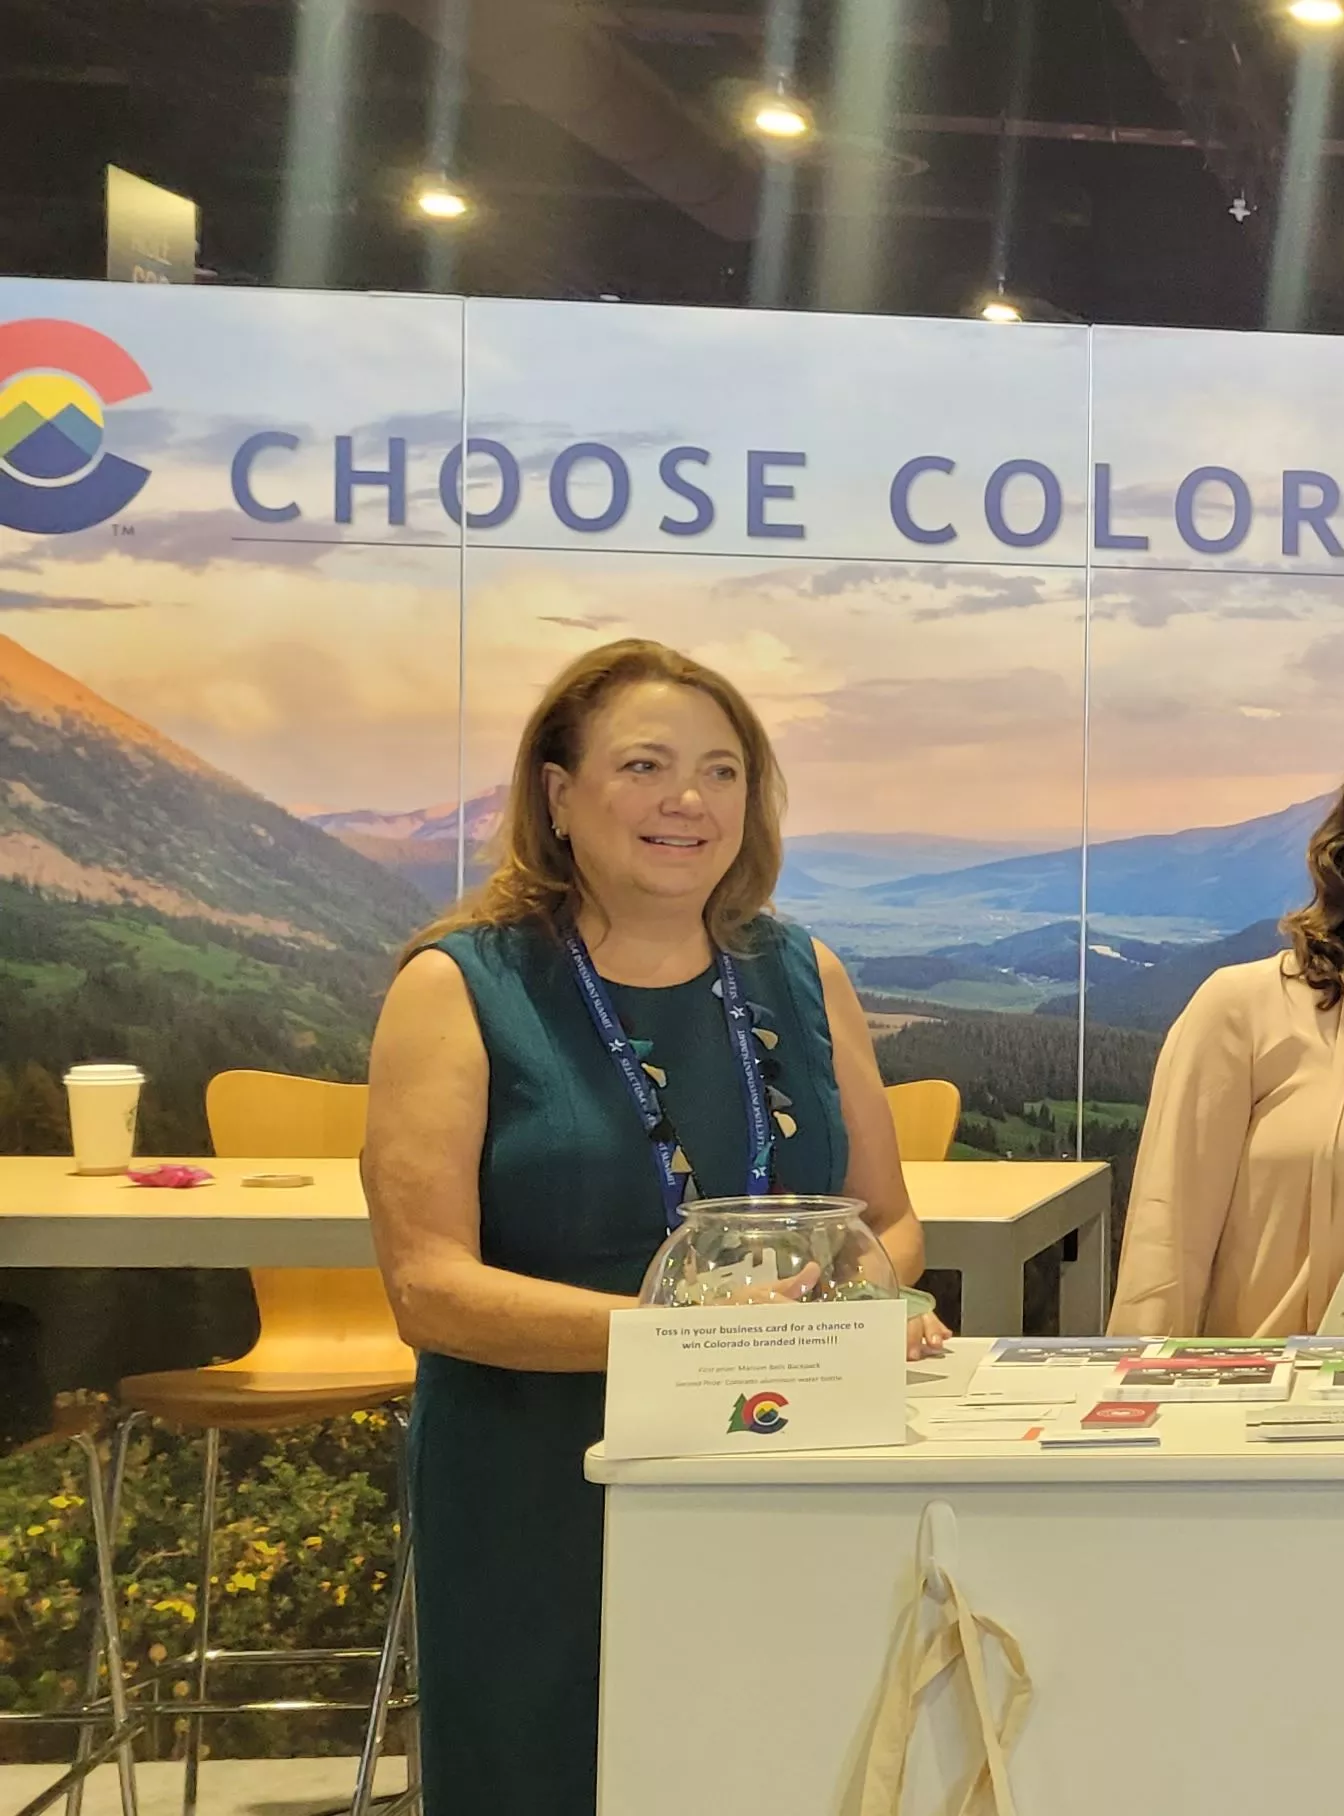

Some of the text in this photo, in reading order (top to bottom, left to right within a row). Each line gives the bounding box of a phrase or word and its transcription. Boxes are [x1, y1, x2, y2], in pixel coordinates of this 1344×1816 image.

[230, 430, 808, 540] CHOOSE
[656, 1328, 678, 1336] Toss
[681, 1327, 690, 1336] in
[693, 1327, 716, 1337] your
[720, 1325, 763, 1334] business
[766, 1324, 787, 1332] card
[790, 1323, 804, 1332] for
[816, 1322, 851, 1331] chance
[854, 1321, 864, 1330] to
[682, 1340, 701, 1349] win
[703, 1339, 750, 1349] Colorado
[753, 1337, 795, 1347] branded
